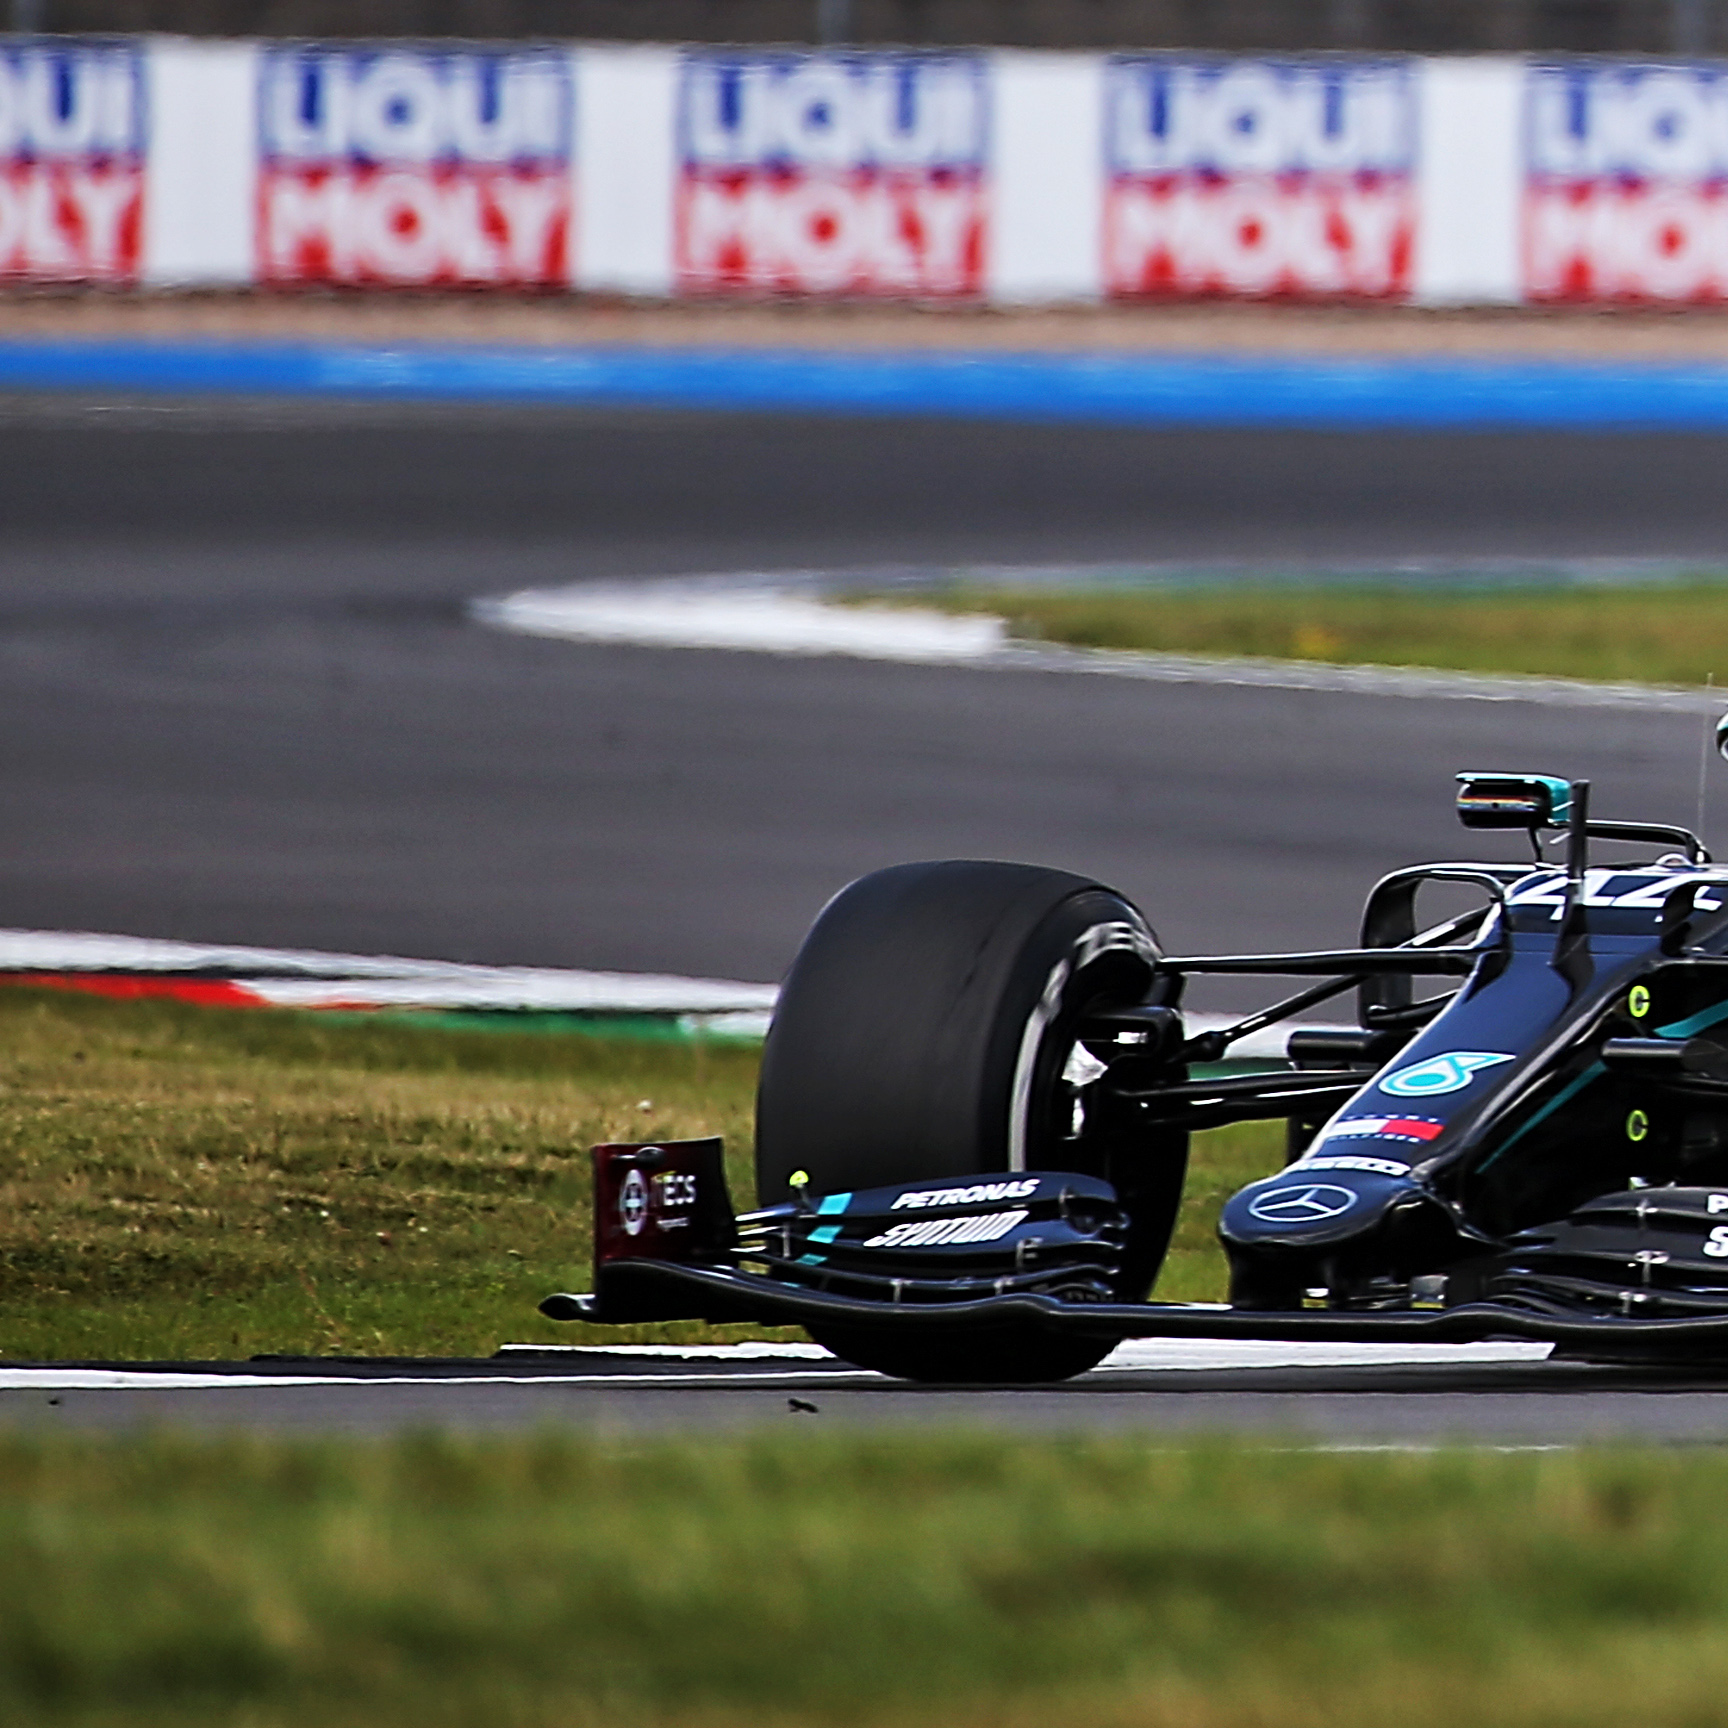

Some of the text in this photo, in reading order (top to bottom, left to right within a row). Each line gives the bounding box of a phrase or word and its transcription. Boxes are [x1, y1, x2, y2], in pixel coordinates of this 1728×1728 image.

[265, 164, 568, 277] MOLY
[685, 173, 988, 283] MOLY
[1110, 178, 1416, 287] MOLY
[863, 1209, 1030, 1248] SYNTIUM
[890, 1177, 1042, 1211] PETRONAS
